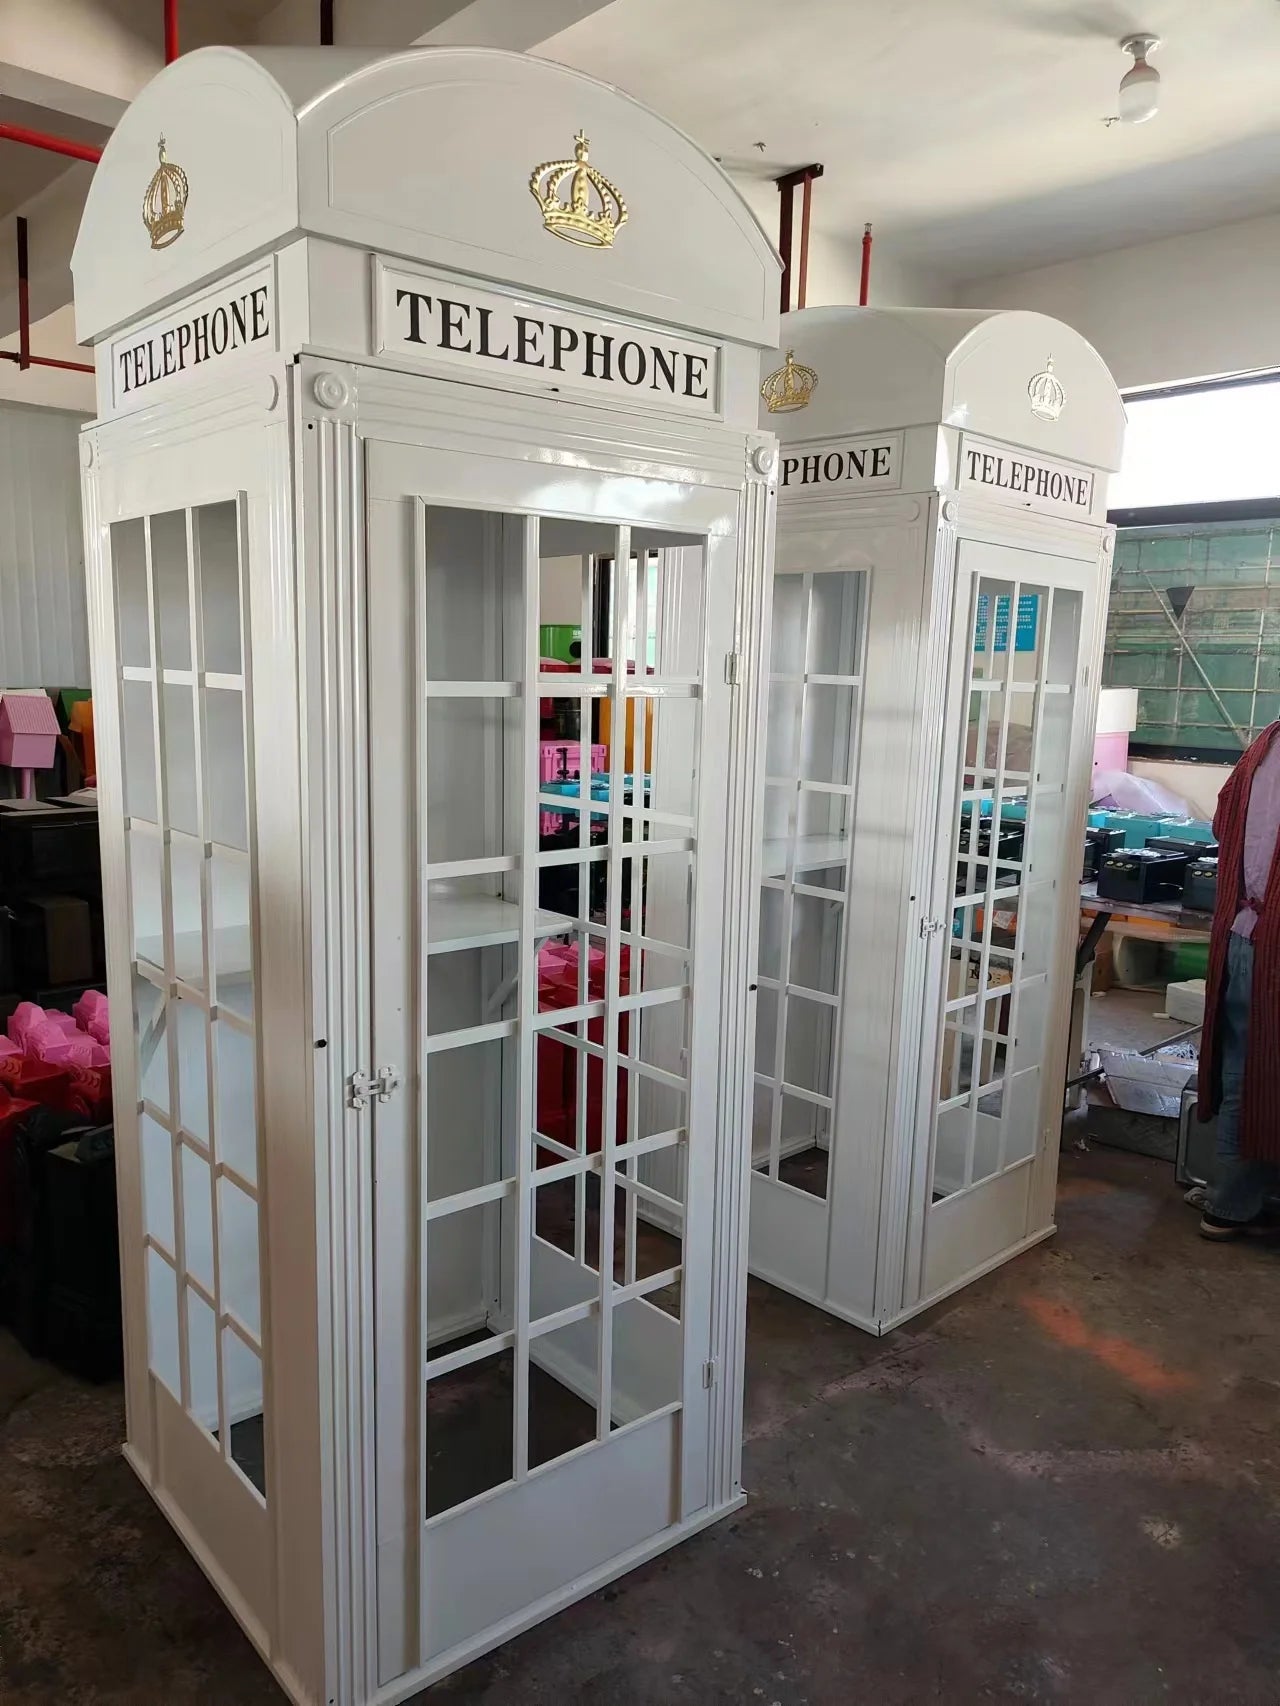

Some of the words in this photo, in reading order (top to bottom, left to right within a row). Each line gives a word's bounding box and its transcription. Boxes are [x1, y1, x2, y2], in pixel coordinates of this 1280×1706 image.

[120, 285, 270, 394] TELEPHONE
[396, 288, 708, 400] TELEPHONE
[967, 450, 1088, 505] TELEPHONE
